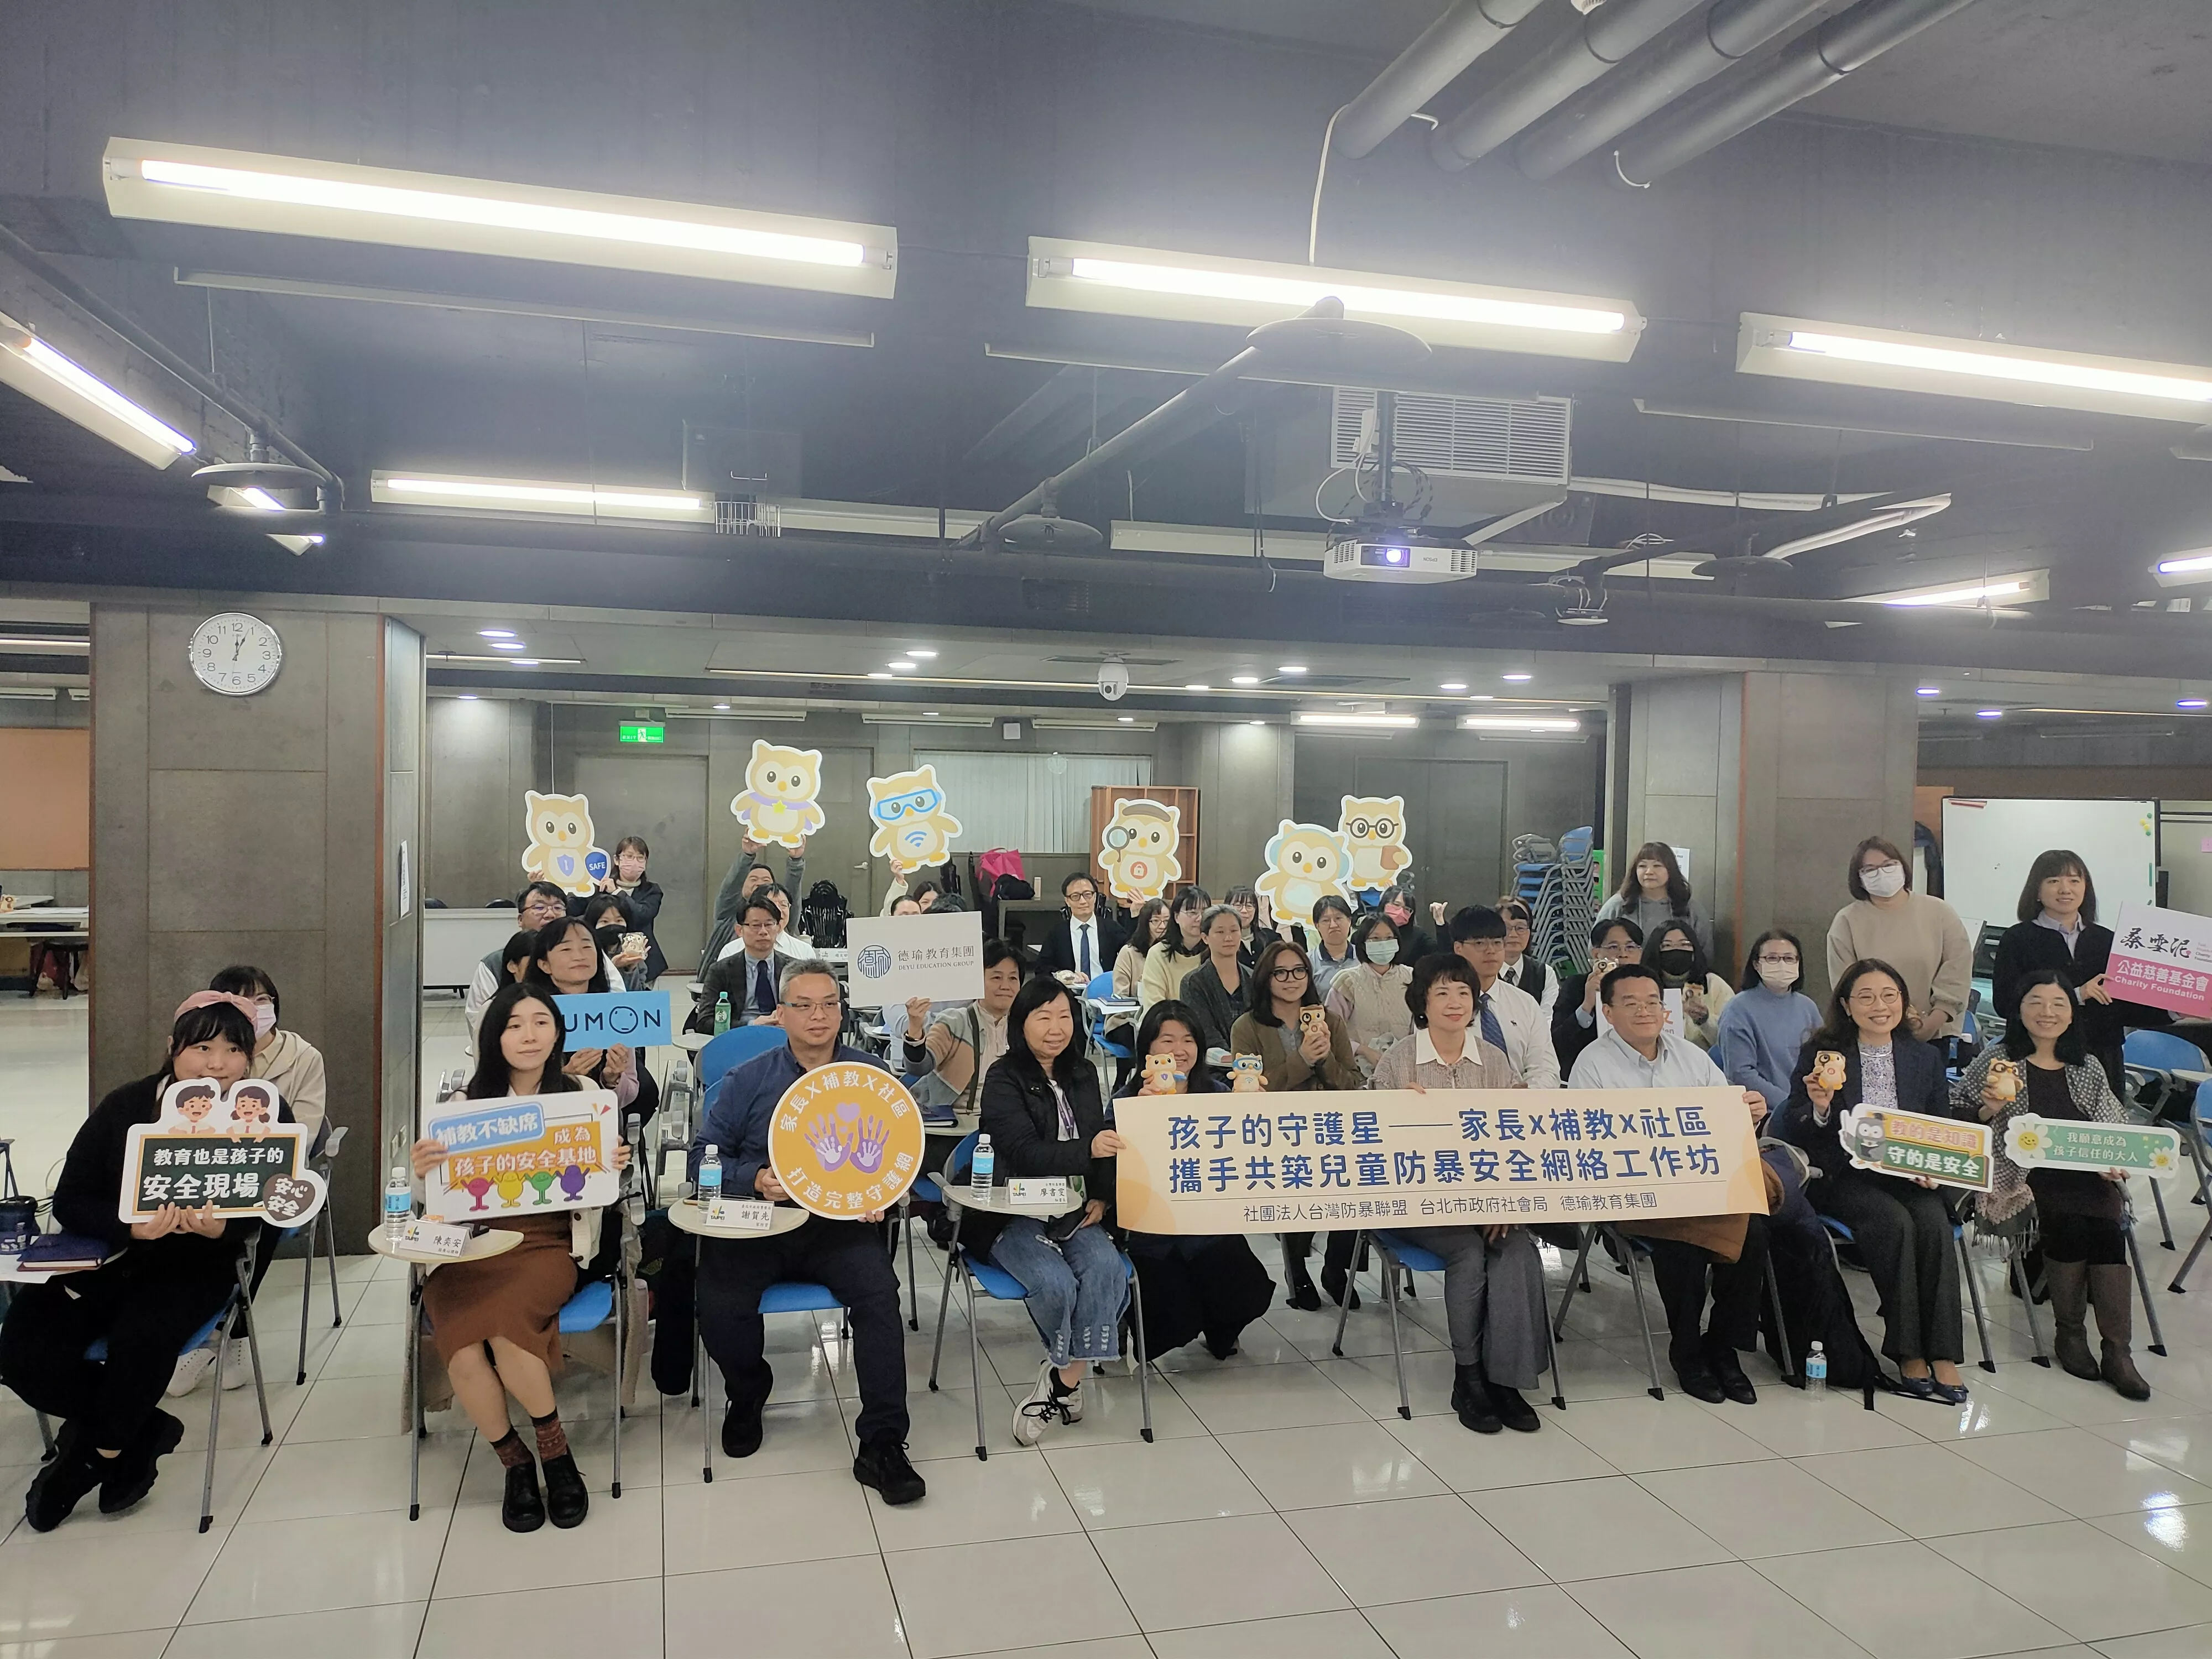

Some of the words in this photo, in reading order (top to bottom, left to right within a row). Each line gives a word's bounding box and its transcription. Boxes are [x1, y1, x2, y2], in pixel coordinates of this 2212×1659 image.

[217, 625, 226, 634] 11
[232, 623, 243, 632] 12
[206, 635, 218, 644] 10
[259, 637, 268, 646] 2
[202, 649, 212, 658] 9
[262, 651, 271, 660] 3
[207, 662, 216, 671] 8
[258, 664, 267, 673] 4
[218, 672, 227, 682] 7
[232, 676, 241, 685] 6
[247, 674, 256, 682] 5
[589, 862, 606, 871] SAFE
[898, 946, 974, 962] 德瑜教育集團
[2116, 959, 2209, 992] 公益慈善基金會
[2115, 975, 2148, 989] Charity
[2151, 983, 2204, 1001] Foundation
[562, 1006, 661, 1034] UMON
[435, 1112, 538, 1147] 補教不缺席
[554, 1126, 591, 1145] 成為
[1891, 1119, 1978, 1150] 教的是知識
[2067, 1132, 2126, 1147] 我願意成為
[154, 1147, 284, 1166] 教育也是孩子的
[455, 1146, 597, 1177] 孩子的安全基地
[1887, 1145, 1980, 1178] 守的是安全
[2053, 1145, 2138, 1162] 孩子信任的大人
[1169, 1144, 1720, 1193] 攜手共築兒童防暴安全網絡工作坊
[142, 1172, 260, 1201] 安全現場
[275, 1177, 308, 1198] 安心
[786, 1152, 913, 1210] 打造完整守護網
[267, 1194, 300, 1217] 安全
[1244, 1199, 1408, 1222] 社團法人台灣防暴聯盟
[1420, 1196, 1548, 1215] 台北市政府社會局
[1559, 1192, 1658, 1212] 德瑜教育集團
[742, 1211, 769, 1221] 謝賀先
